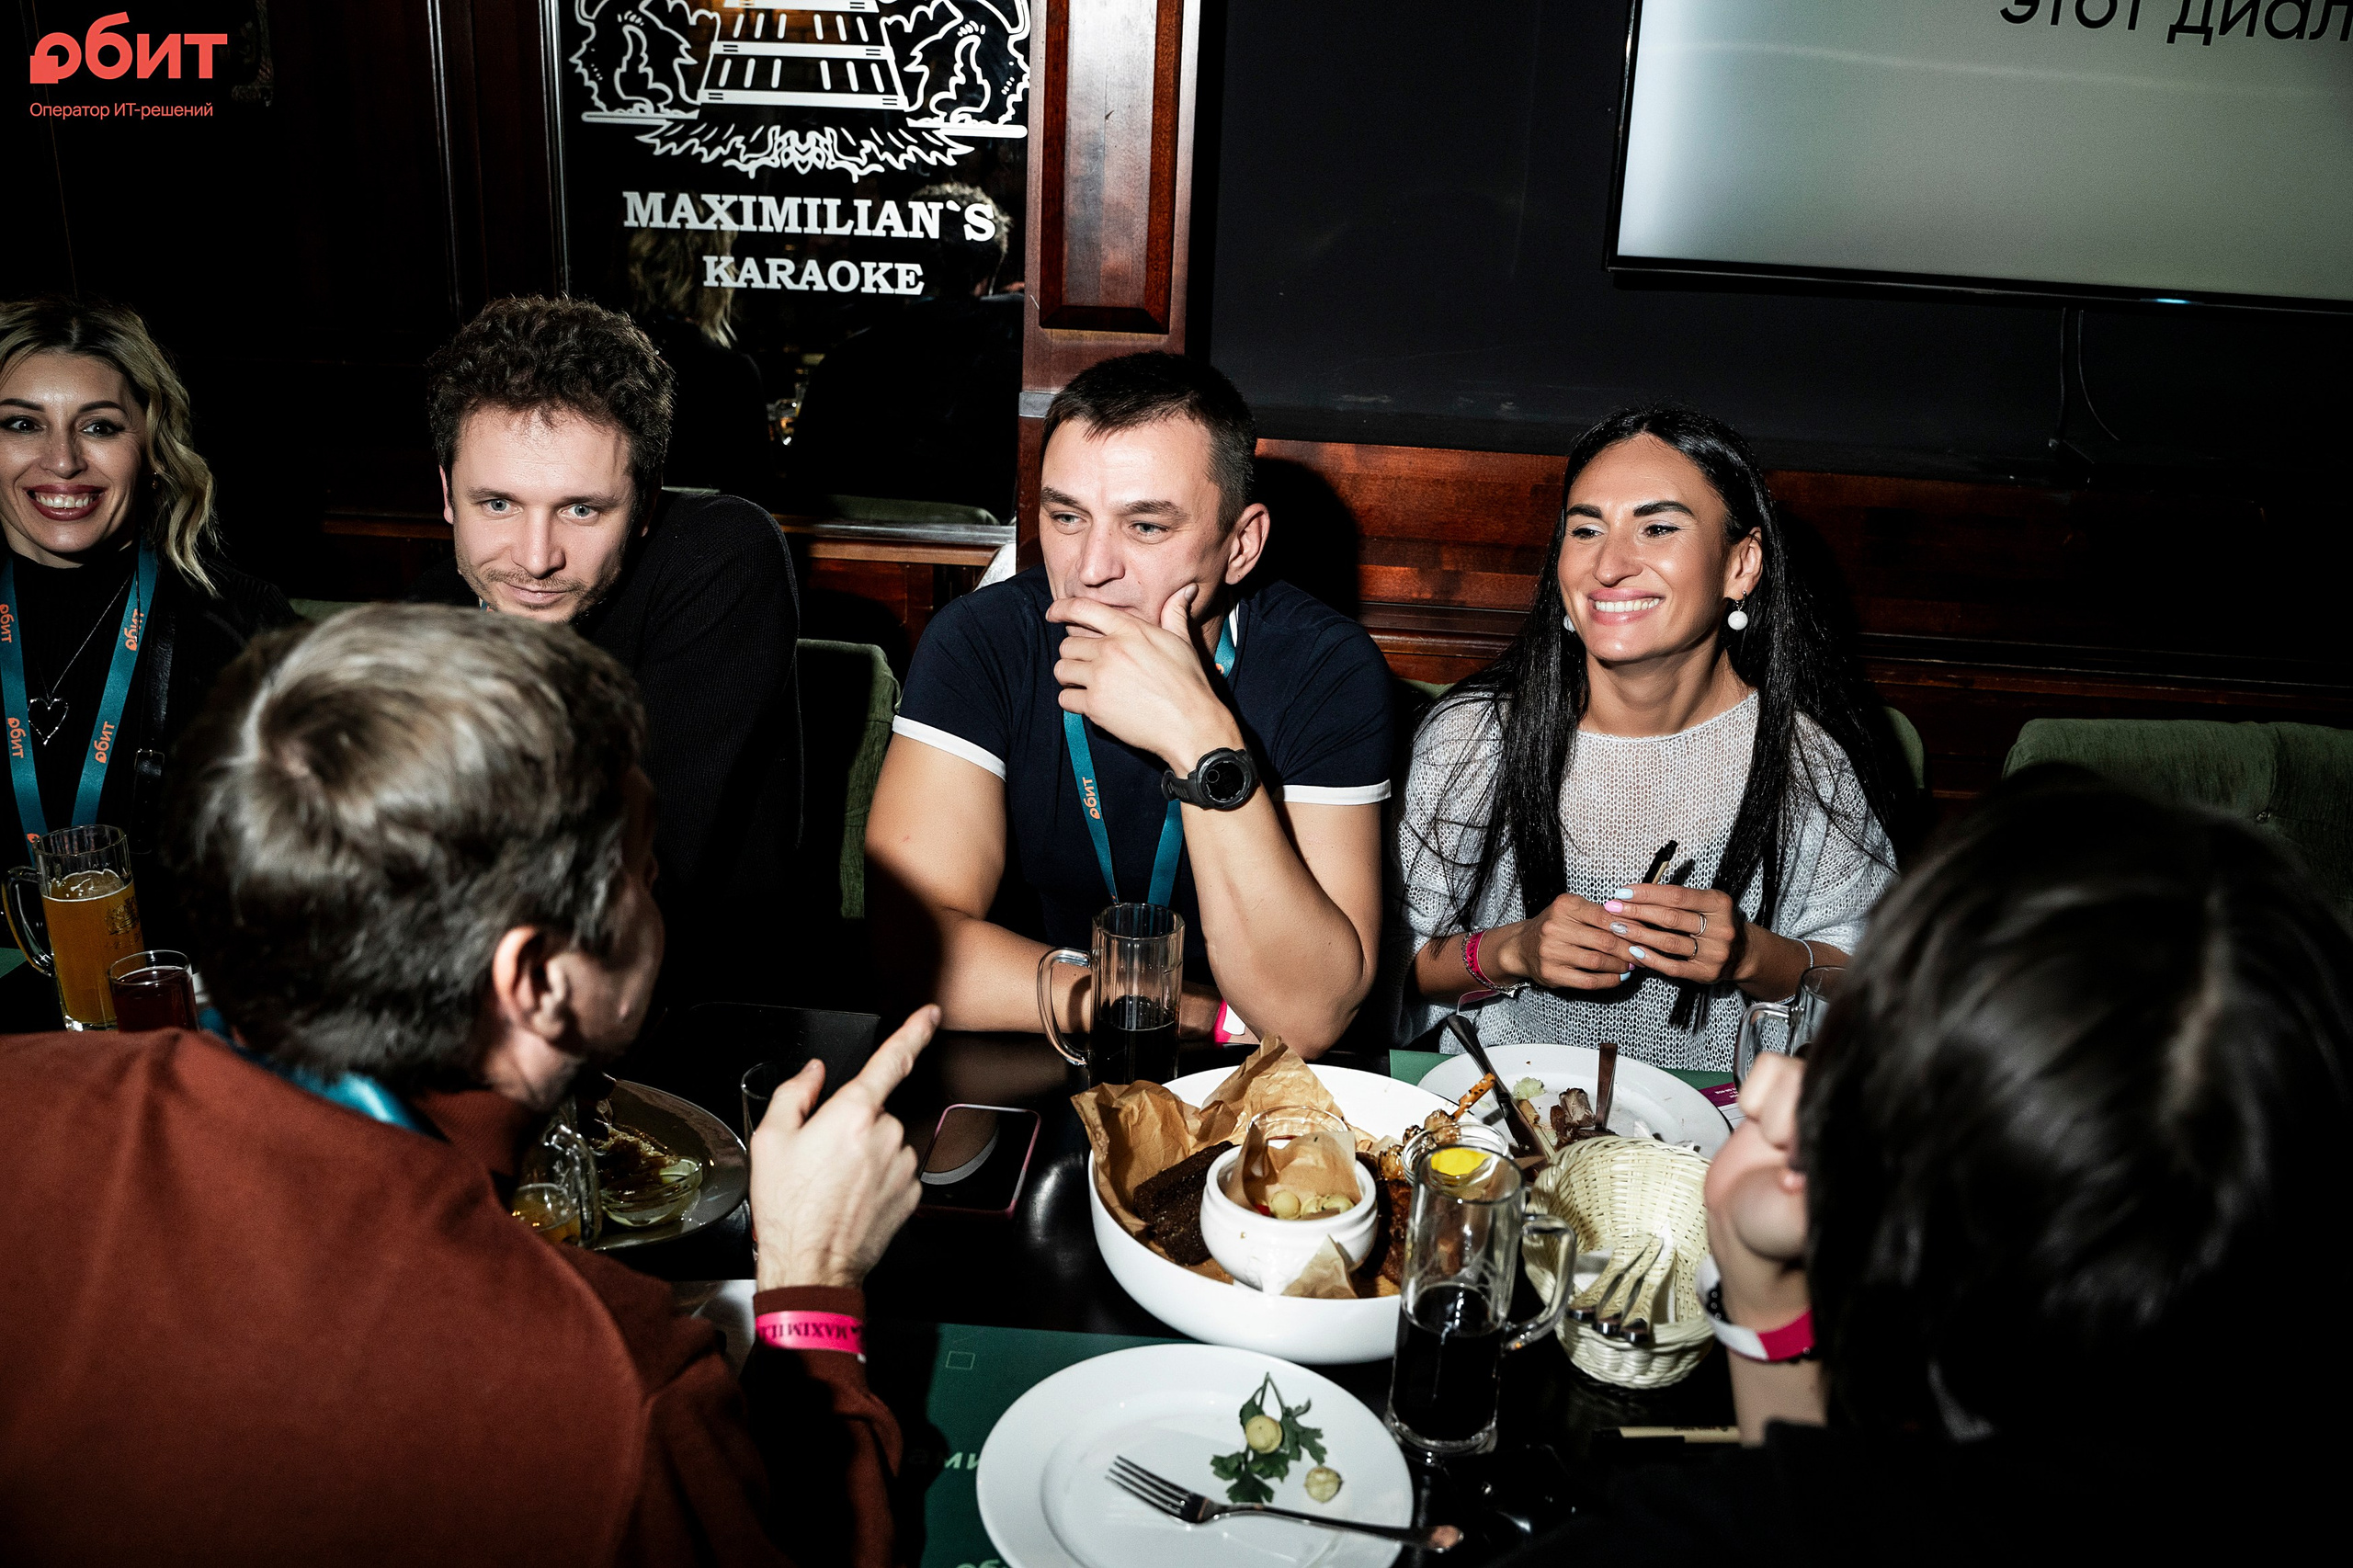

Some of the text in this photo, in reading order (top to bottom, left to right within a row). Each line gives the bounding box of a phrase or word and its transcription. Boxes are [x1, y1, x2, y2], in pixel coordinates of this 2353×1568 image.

[702, 255, 925, 296] KARAOKE
[7, 717, 26, 758] обит
[95, 721, 115, 764] обит
[1082, 777, 1101, 820] обит
